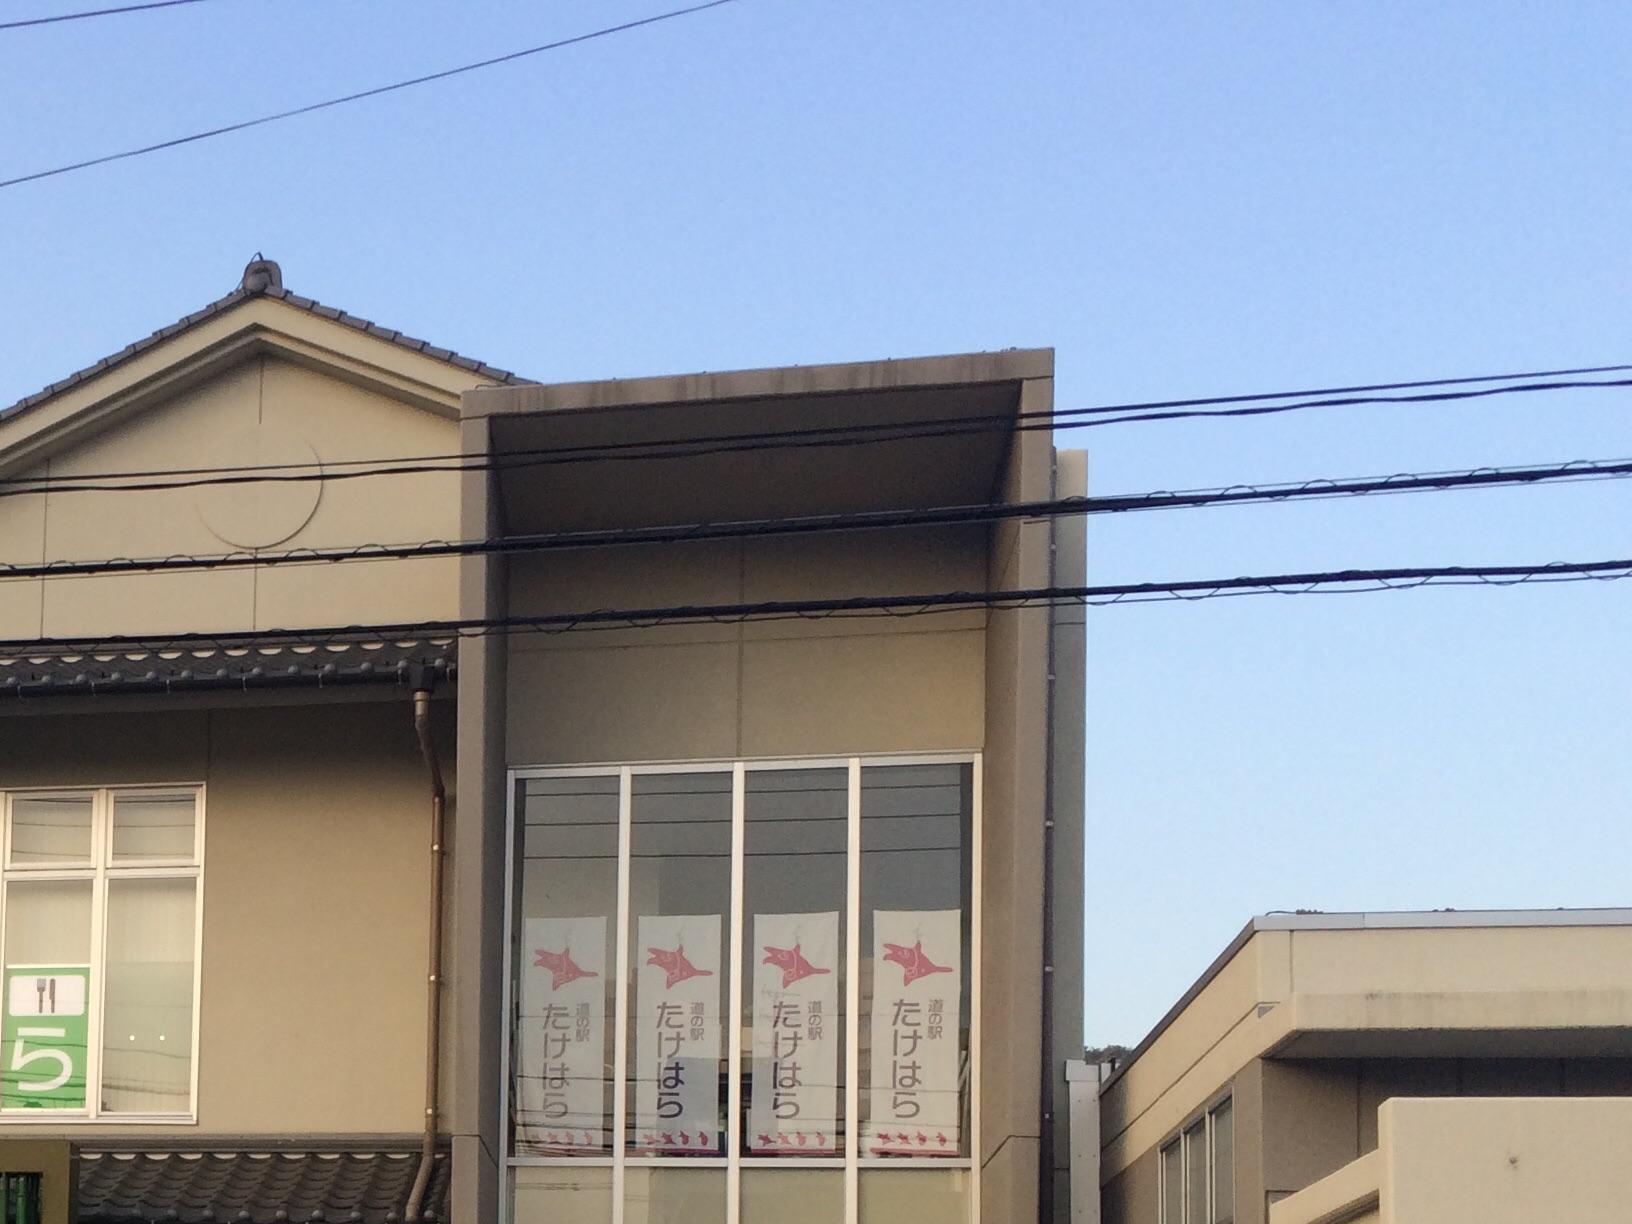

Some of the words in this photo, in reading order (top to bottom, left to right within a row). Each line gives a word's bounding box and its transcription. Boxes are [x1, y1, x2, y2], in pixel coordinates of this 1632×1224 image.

[576, 1002, 590, 1042] 道の駅
[690, 1001, 705, 1041] 道の駅
[808, 1000, 823, 1040] 道の駅
[892, 999, 923, 1118] たけはら
[928, 998, 944, 1040] 道の駅
[542, 1003, 571, 1119] たけはら
[656, 1002, 686, 1118] たけはら
[772, 1001, 803, 1119] たけはら
